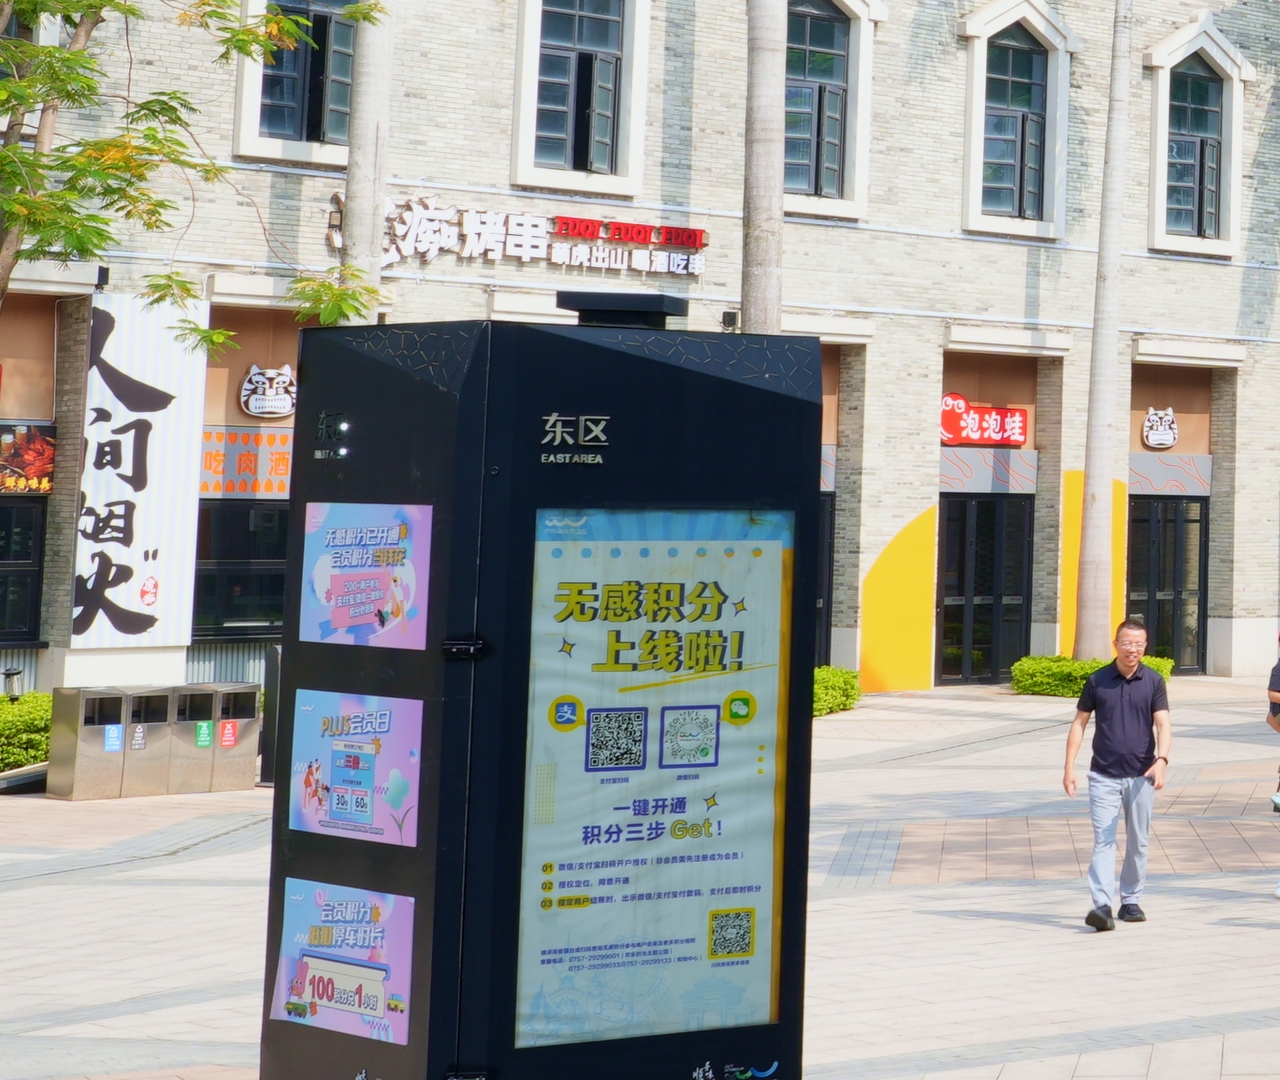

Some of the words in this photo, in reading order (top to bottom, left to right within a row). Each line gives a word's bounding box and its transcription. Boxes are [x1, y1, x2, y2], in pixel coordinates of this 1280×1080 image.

[541, 412, 611, 446] 东区
[959, 410, 1025, 443] 泡泡蛙
[541, 453, 572, 464] EAST
[572, 453, 604, 464] AREA
[553, 580, 729, 624] 无感积分
[613, 796, 688, 817] 一键开通
[582, 821, 667, 846] 积分三步
[542, 863, 554, 873] 01
[541, 881, 554, 891] 02
[320, 901, 374, 923] 会员积分
[541, 899, 553, 909] 03
